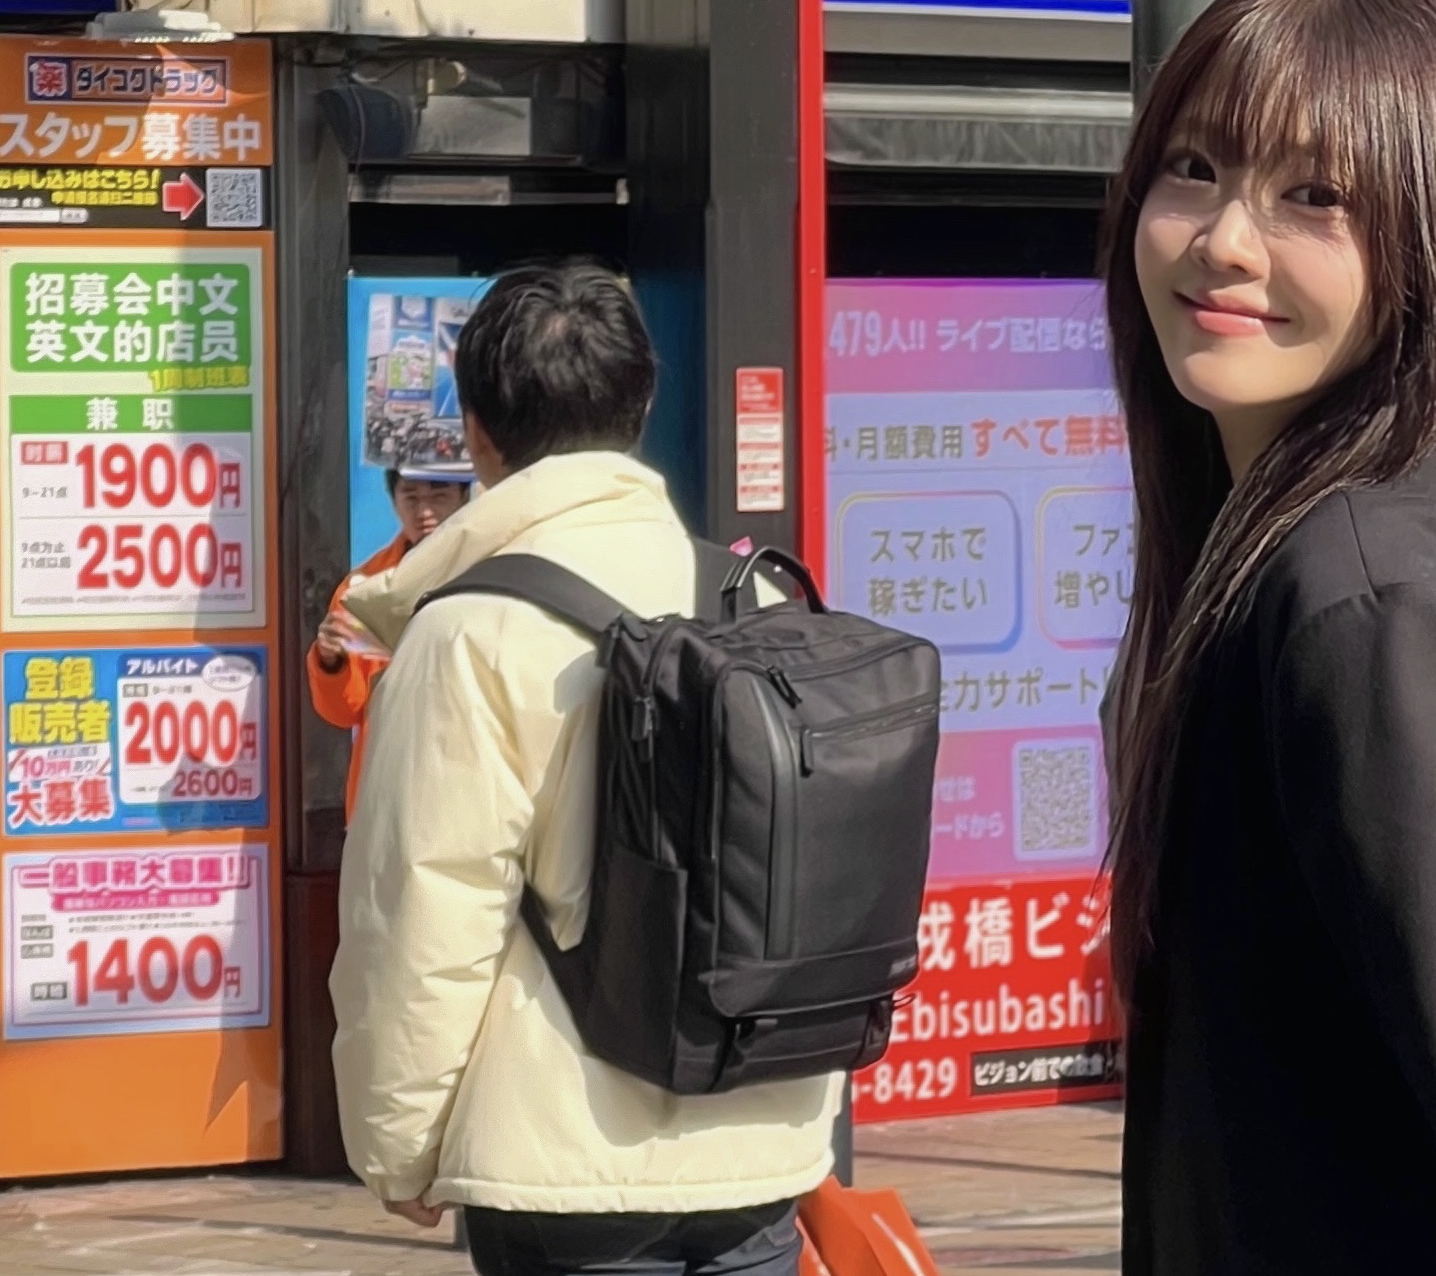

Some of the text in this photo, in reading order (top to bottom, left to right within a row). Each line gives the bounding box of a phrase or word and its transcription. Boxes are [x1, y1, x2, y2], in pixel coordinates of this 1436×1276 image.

[75, 63, 222, 96] ダイコクドラッグ
[0, 112, 262, 161] スタッフ募集中
[25, 272, 239, 317] 招募会中文
[25, 319, 240, 364] 英文的店员
[870, 526, 988, 563] スマホで
[867, 577, 988, 616] 稼ぎたい
[9, 702, 111, 745] 販売者
[10, 779, 112, 824] 大募集
[852, 1058, 957, 1104] -8429
